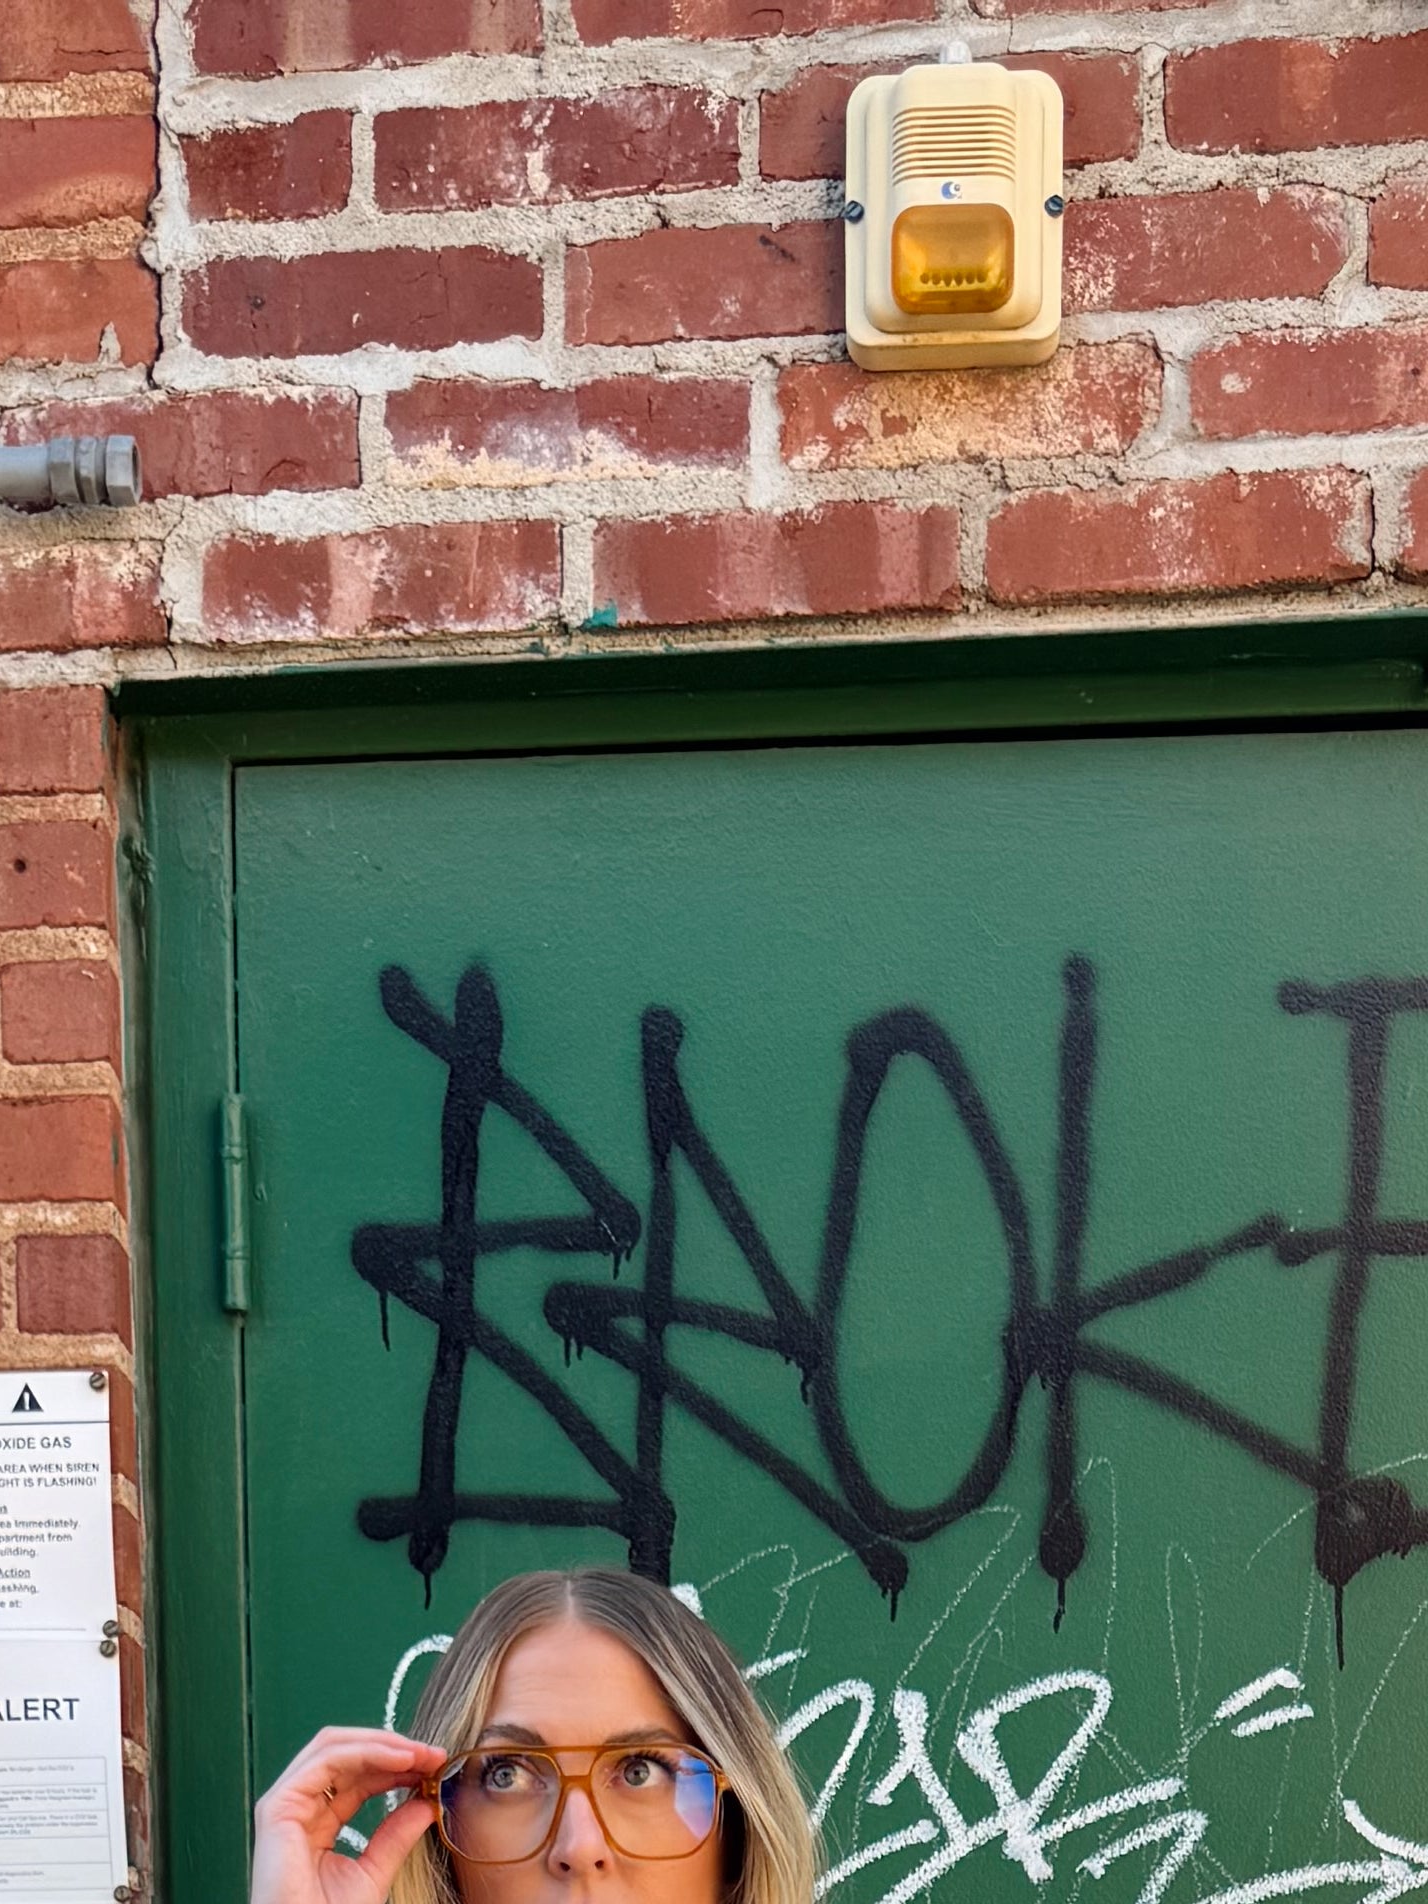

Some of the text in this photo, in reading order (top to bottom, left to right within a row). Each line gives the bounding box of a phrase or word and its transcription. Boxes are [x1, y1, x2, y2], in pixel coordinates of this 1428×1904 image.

[40, 1436, 72, 1449] GAS
[29, 1463, 63, 1473] WHEN
[66, 1462, 100, 1473] SIREN
[23, 1477, 34, 1488] IS
[48, 1532, 73, 1542] from
